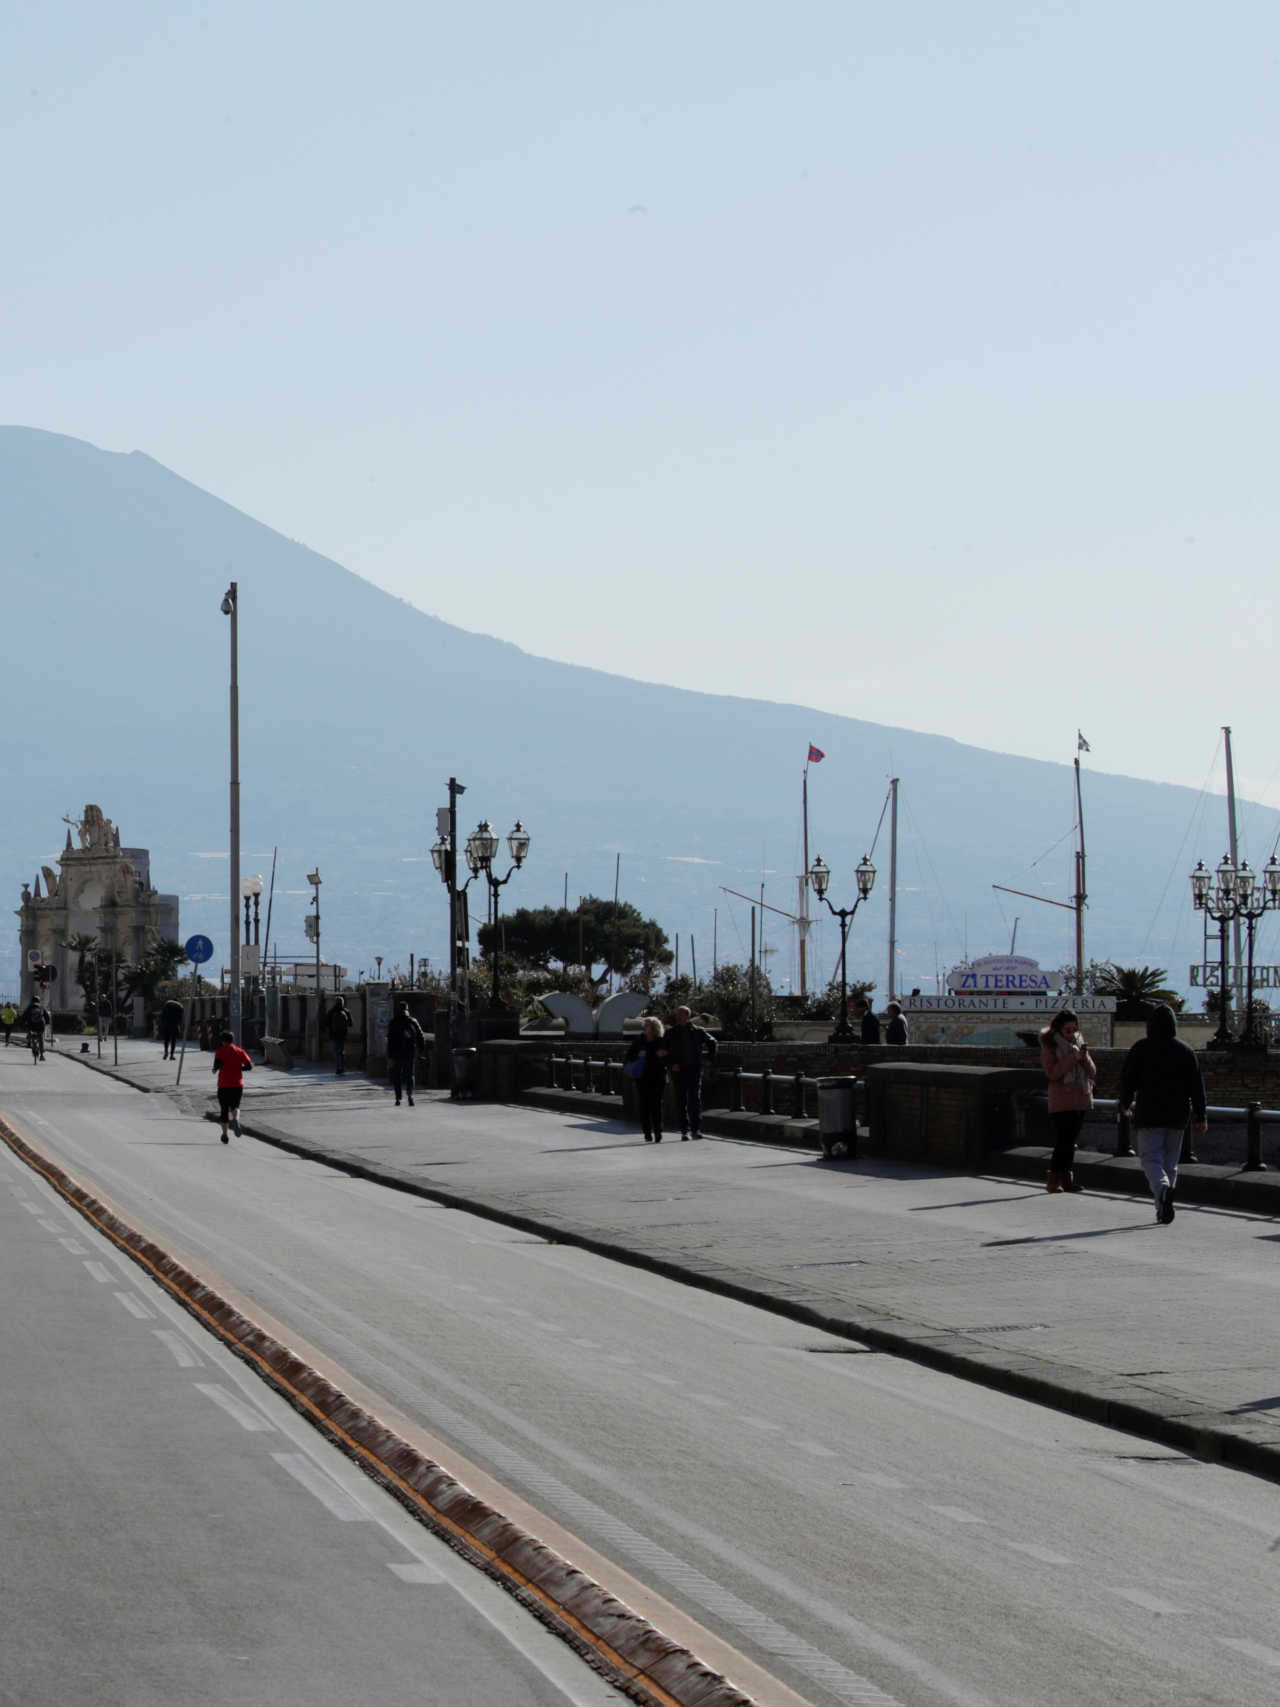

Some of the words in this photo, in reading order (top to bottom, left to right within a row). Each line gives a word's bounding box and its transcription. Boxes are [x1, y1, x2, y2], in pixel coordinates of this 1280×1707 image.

[981, 973, 1051, 989] TERESA
[909, 998, 1009, 1009] RISTORANTE
[1035, 998, 1107, 1009] PIZZERIA
